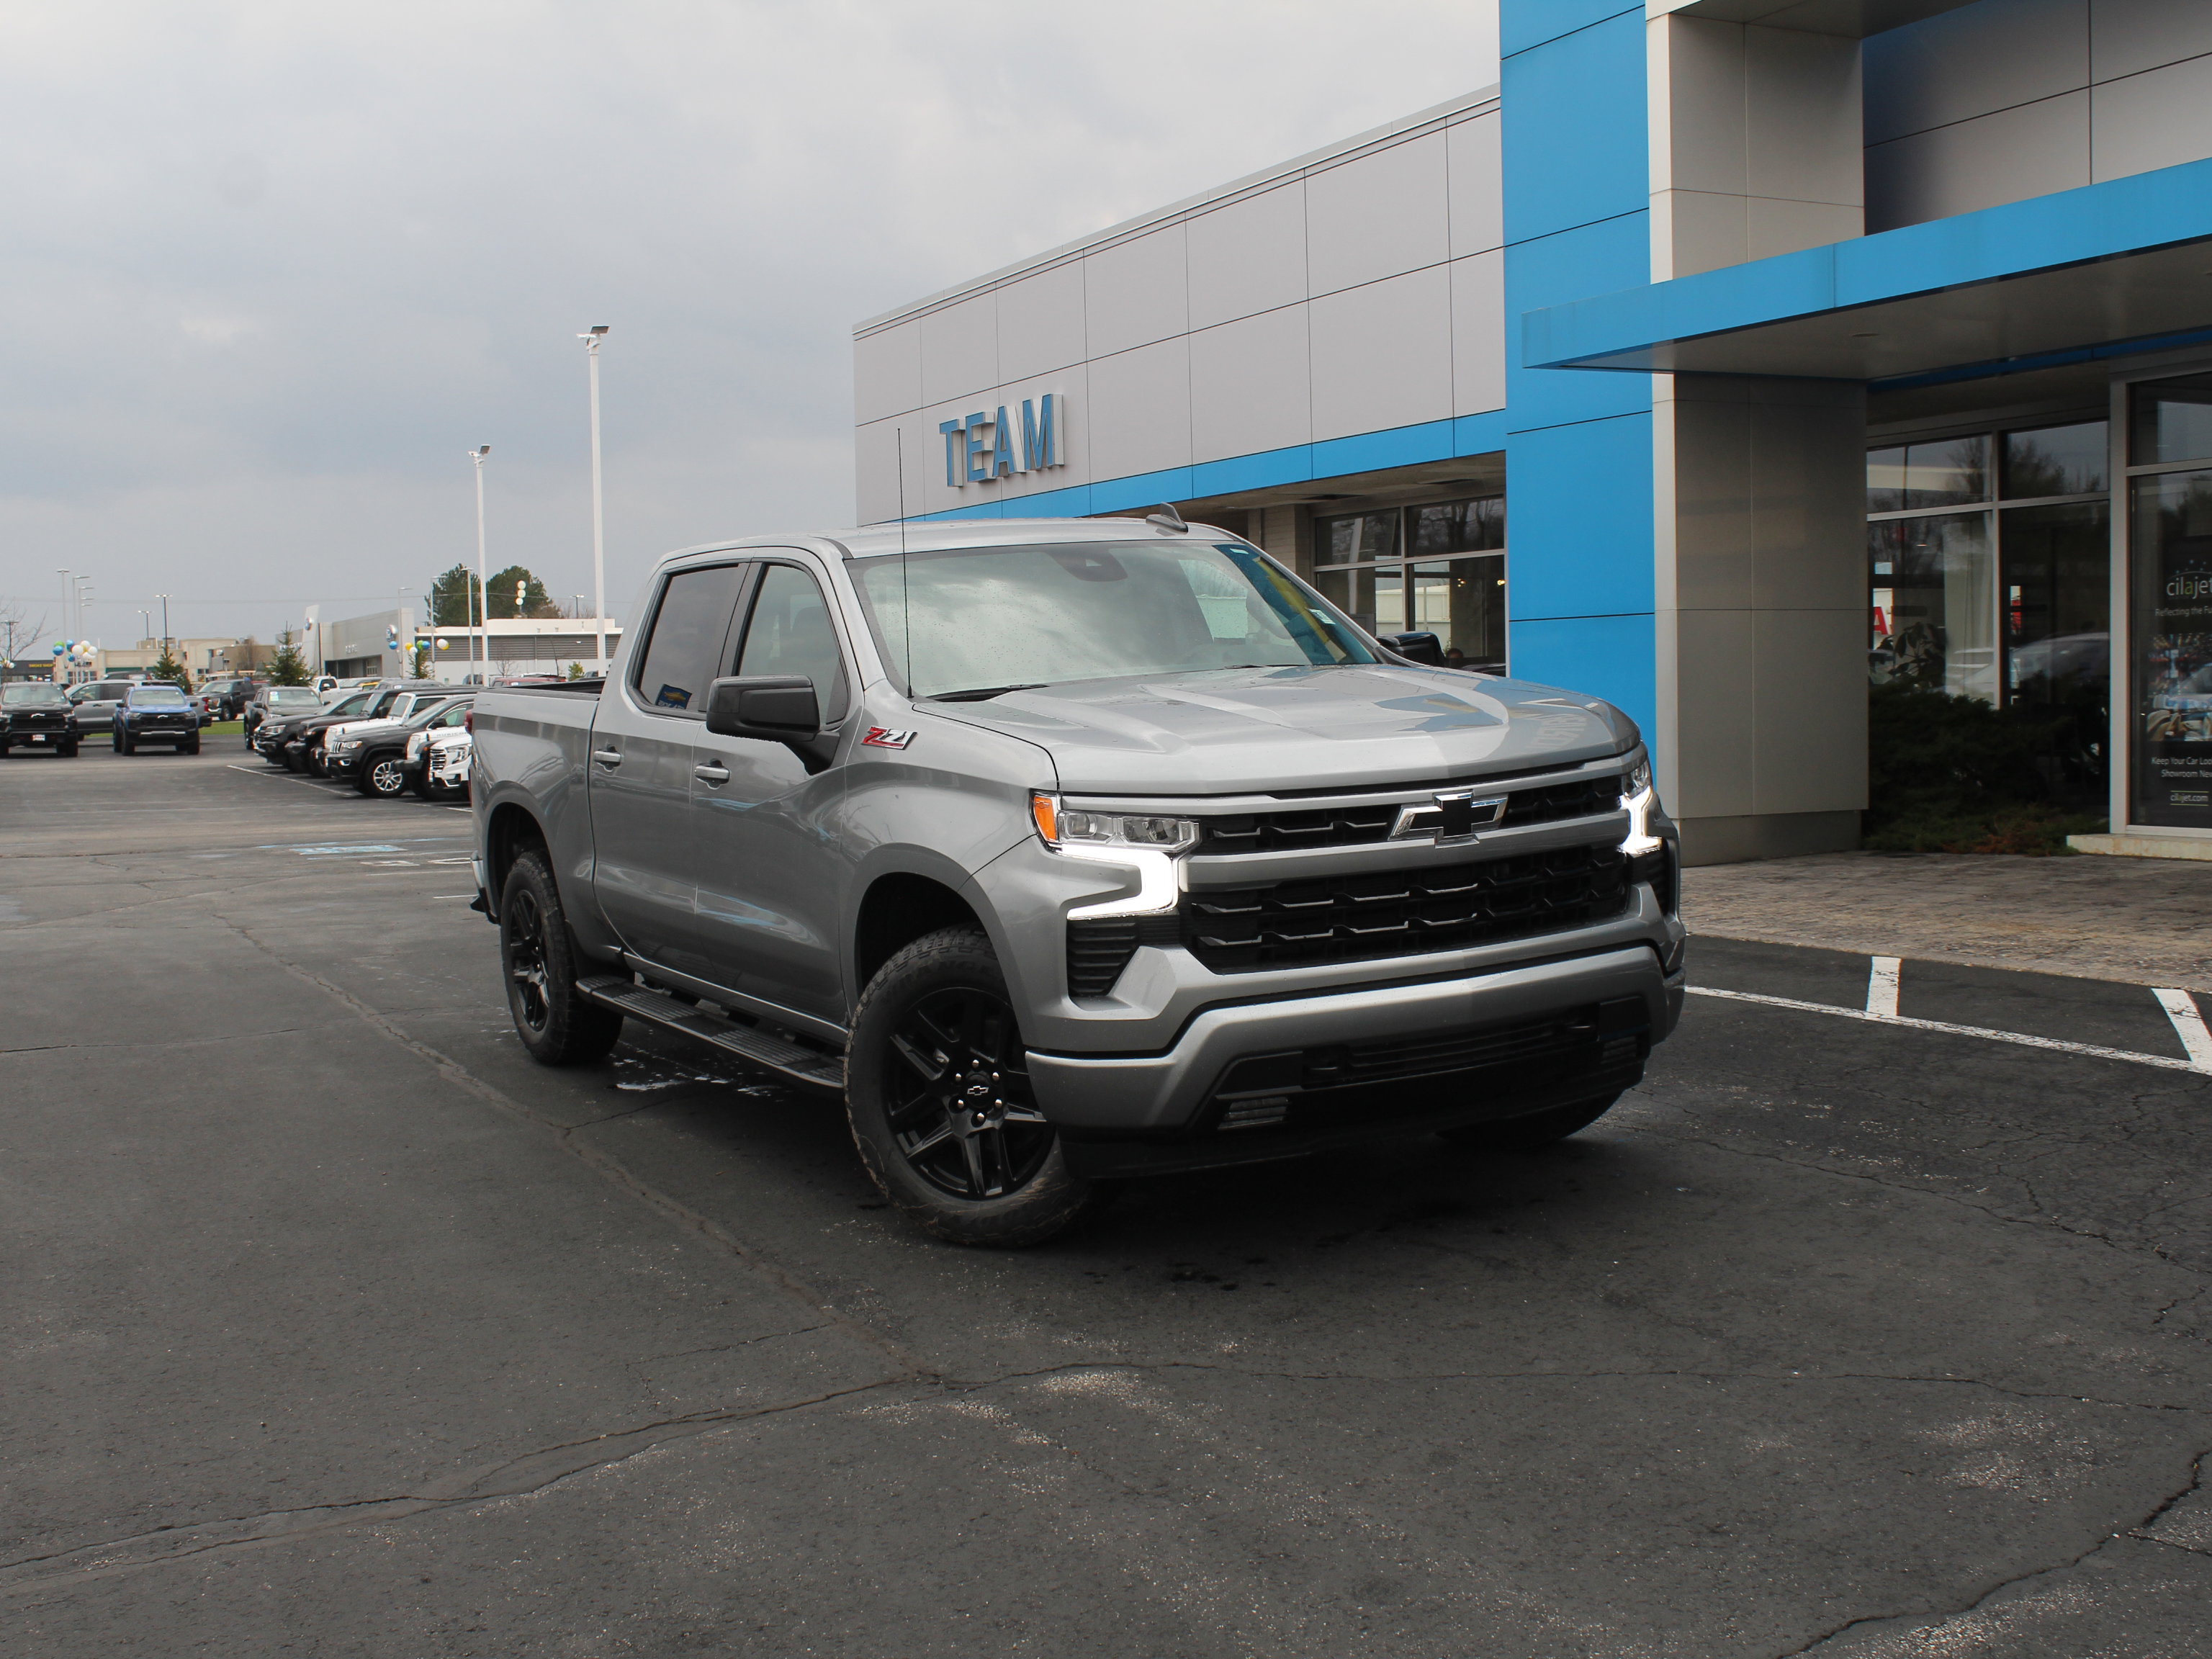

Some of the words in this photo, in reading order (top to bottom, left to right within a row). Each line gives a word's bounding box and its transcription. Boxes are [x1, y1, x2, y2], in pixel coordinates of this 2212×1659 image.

[939, 393, 1064, 487] TEAM
[2166, 576, 2212, 599] cilajet
[2155, 608, 2190, 617] Reflecting
[2191, 606, 2203, 615] the
[861, 725, 917, 750] Z71
[2152, 757, 2170, 766] Keep
[2161, 769, 2198, 778] Showroom
[2170, 793, 2208, 803] cilajet.com
